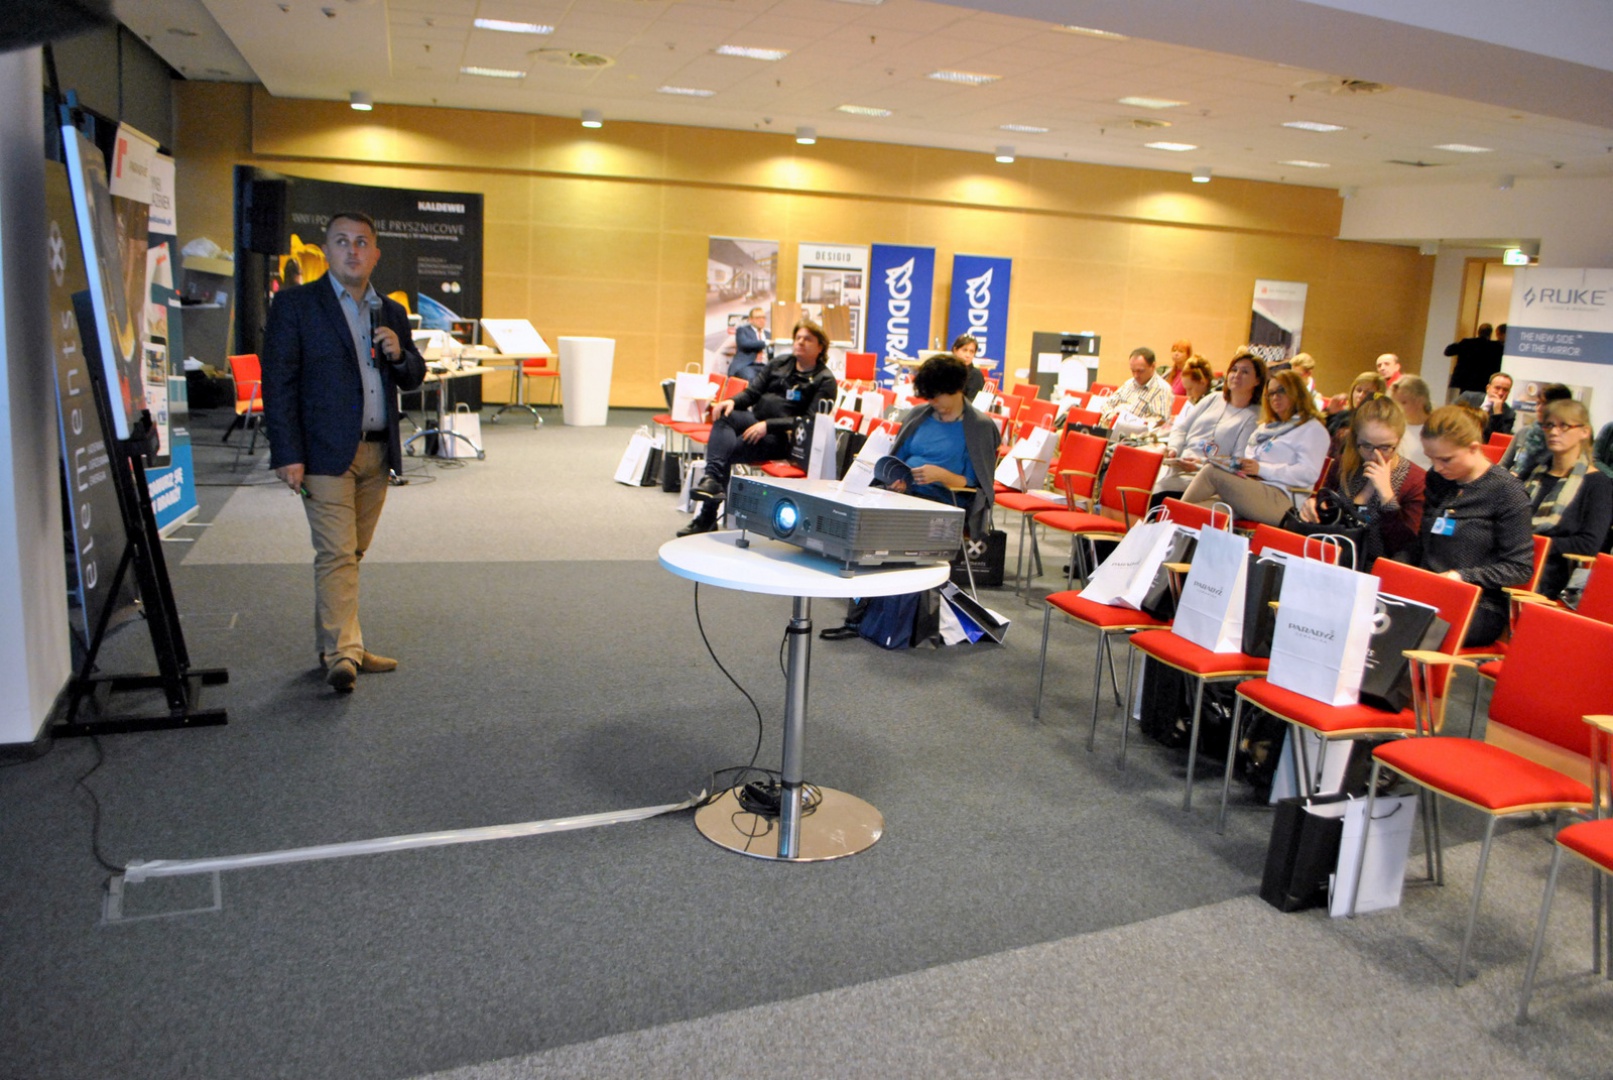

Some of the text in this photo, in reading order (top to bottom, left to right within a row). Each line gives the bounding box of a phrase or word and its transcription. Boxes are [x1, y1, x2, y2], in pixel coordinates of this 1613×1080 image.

[418, 201, 466, 214] KALDEWEI
[389, 220, 465, 236] PRYSZNICOWE
[1540, 287, 1607, 306] RUKE
[1520, 332, 1534, 341] THE
[1535, 333, 1555, 342] NEW
[1555, 334, 1575, 344] SIDE
[1518, 343, 1582, 356] OF THE MIRROR
[60, 309, 98, 590] elements
